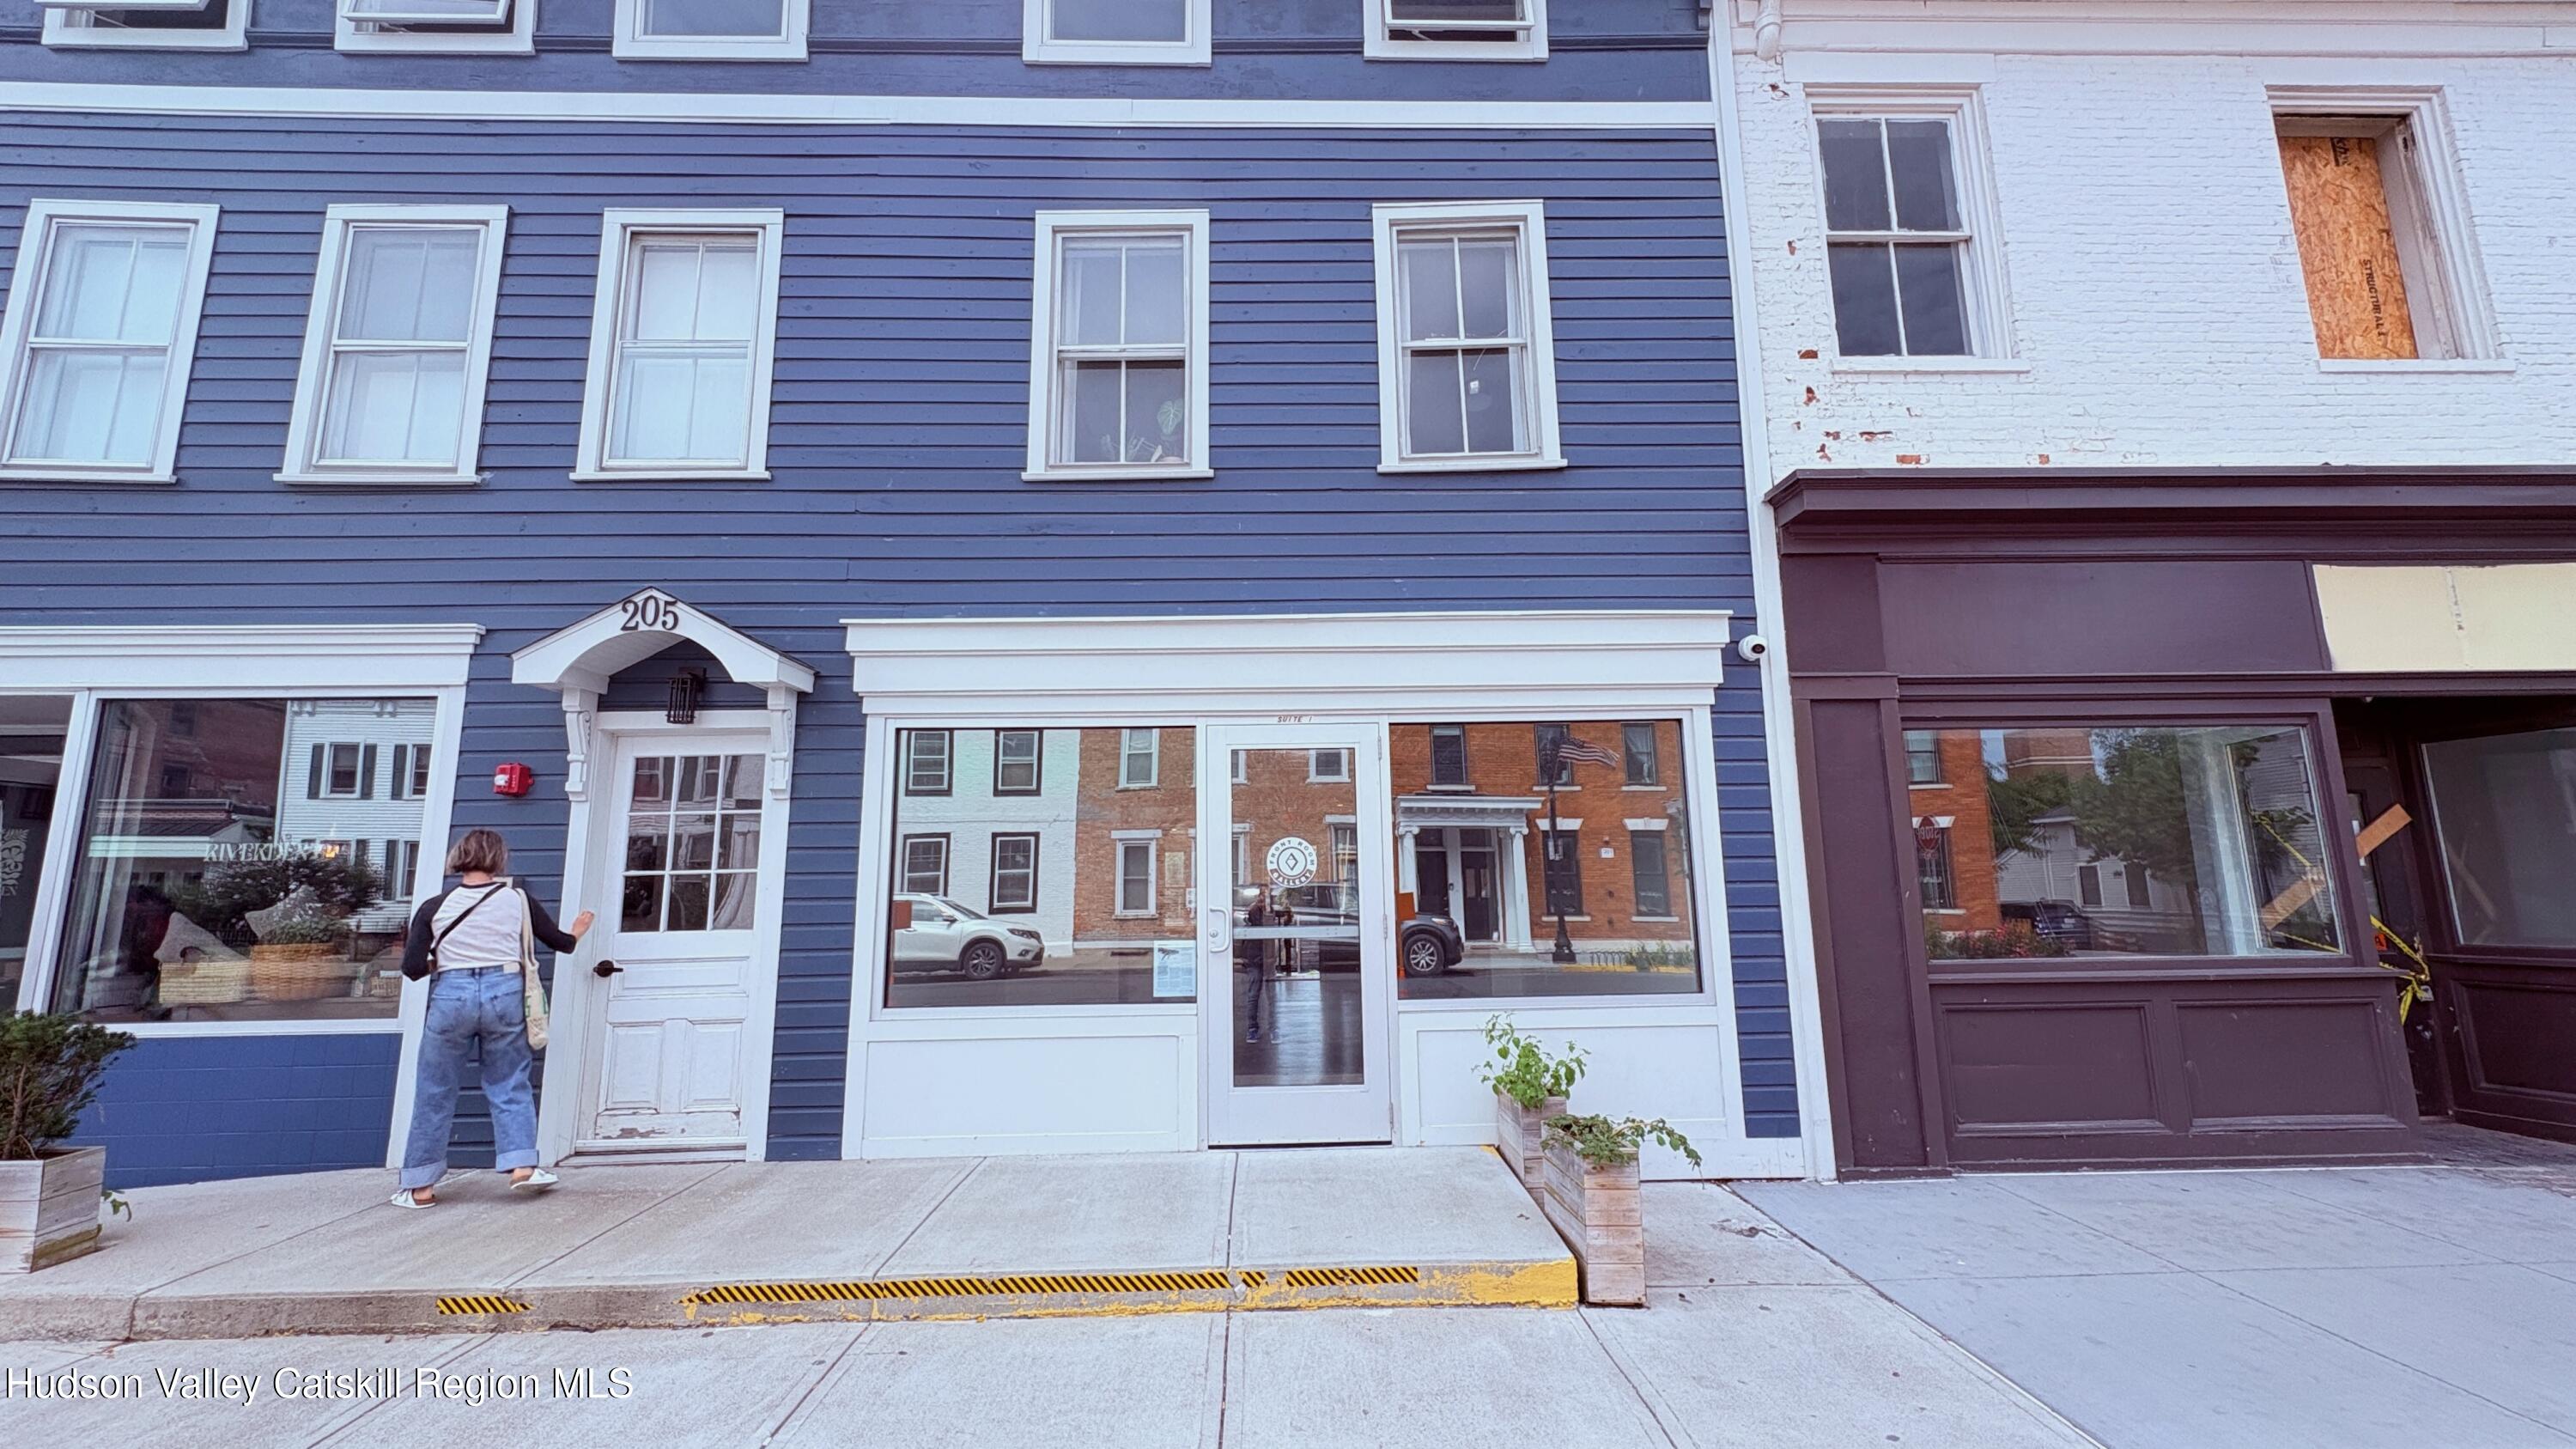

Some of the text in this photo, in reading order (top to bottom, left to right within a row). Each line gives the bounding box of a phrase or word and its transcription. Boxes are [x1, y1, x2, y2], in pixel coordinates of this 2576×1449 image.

[2362, 259, 2384, 329] STRUCTURAL
[620, 594, 679, 631] 205
[1277, 715, 1303, 723] SUITE
[1269, 839, 1315, 866] FRONT ROOM
[1273, 871, 1311, 886] GALLERY
